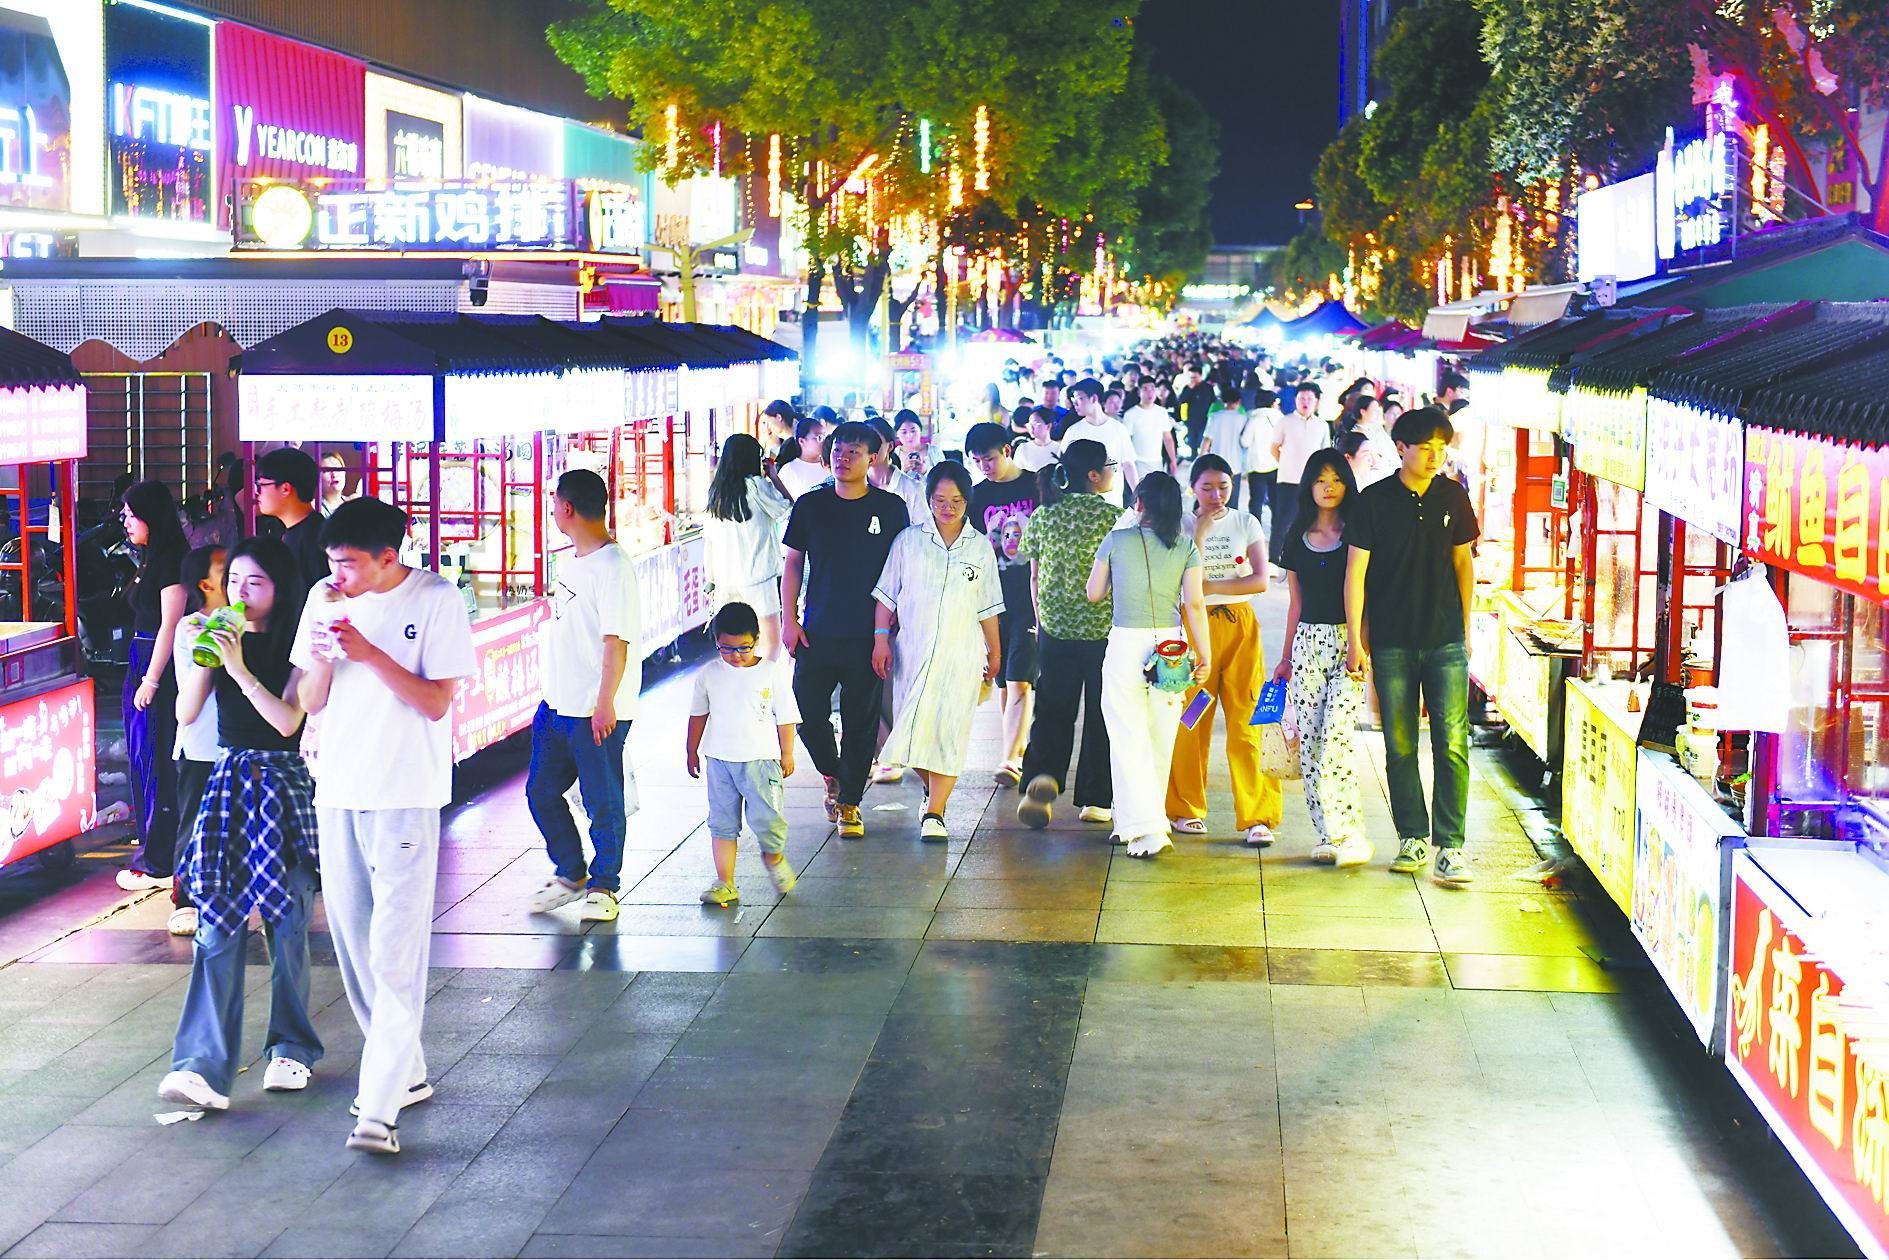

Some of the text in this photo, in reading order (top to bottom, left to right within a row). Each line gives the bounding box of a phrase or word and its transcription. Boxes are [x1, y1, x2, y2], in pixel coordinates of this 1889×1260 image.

[257, 123, 326, 167] YEARCON
[318, 188, 567, 244] 正新鸡排
[333, 334, 348, 347] 13
[867, 515, 882, 535] A
[404, 624, 417, 640] G
